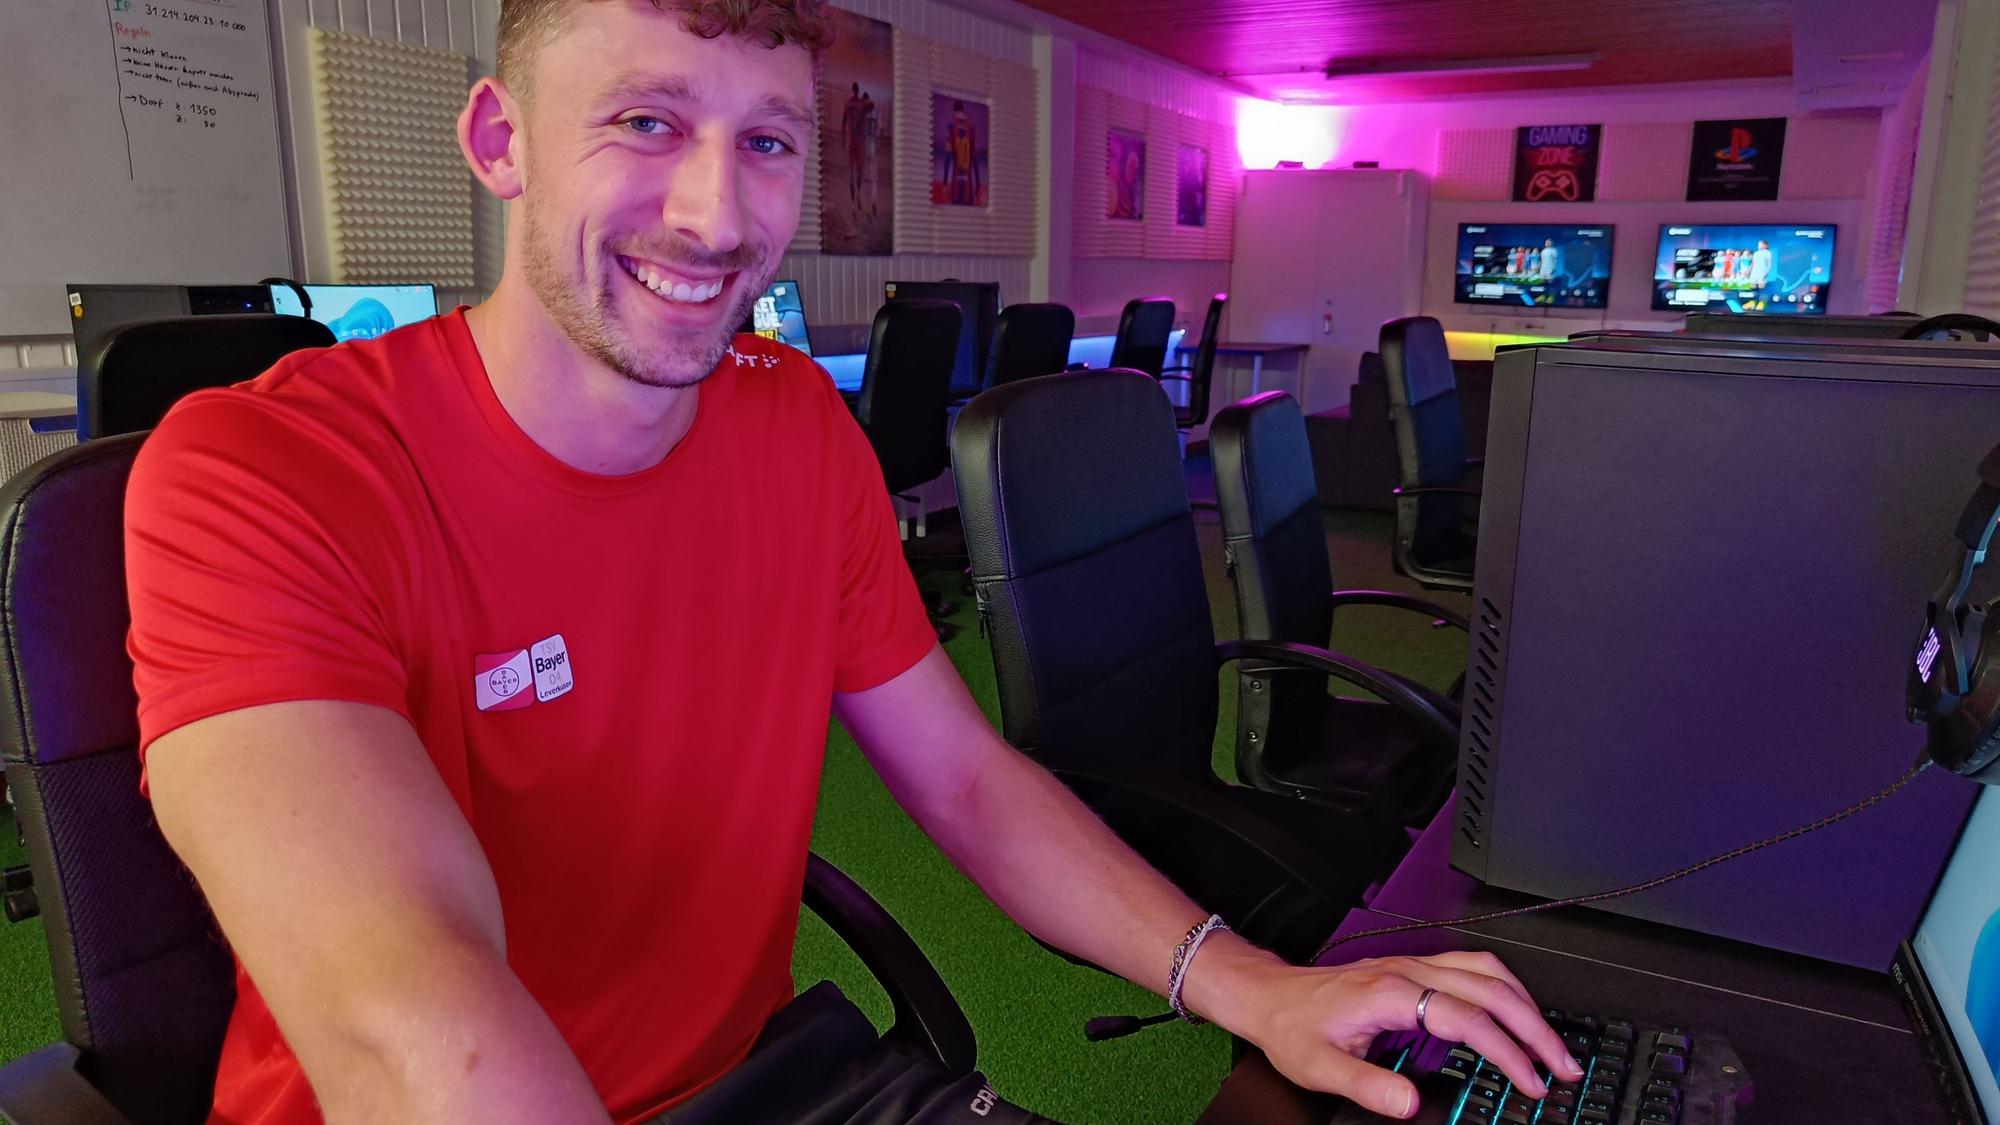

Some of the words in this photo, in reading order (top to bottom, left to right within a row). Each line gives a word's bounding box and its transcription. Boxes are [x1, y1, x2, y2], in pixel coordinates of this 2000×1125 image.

[190, 104, 217, 116] 1350
[1529, 126, 1587, 146] GAMING
[1537, 146, 1575, 166] ZONE
[535, 651, 566, 674] Bayer
[1916, 627, 1941, 684] JBL
[491, 678, 517, 686] BAYER
[540, 680, 573, 699] Leverkusen
